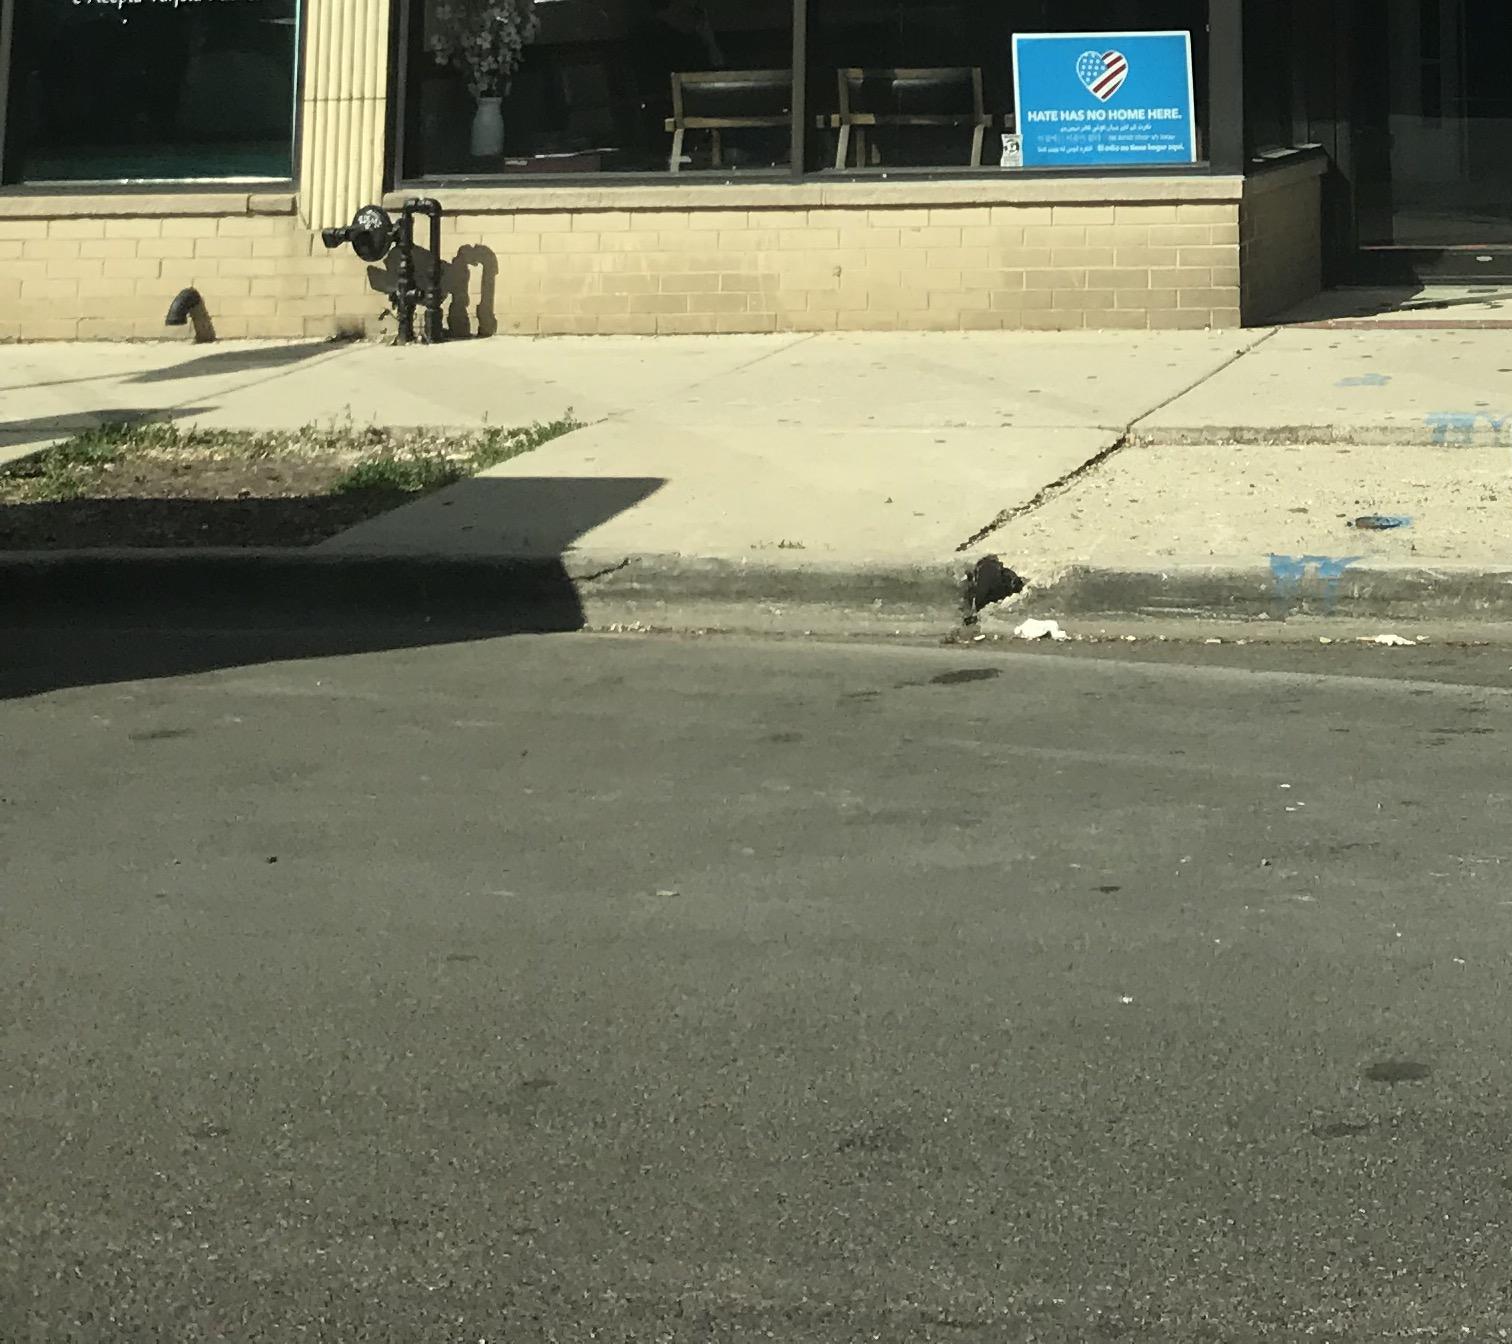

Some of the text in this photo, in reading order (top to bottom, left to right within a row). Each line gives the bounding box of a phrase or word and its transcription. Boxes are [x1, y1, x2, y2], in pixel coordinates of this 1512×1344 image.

[1027, 107, 1182, 123] HATE HAS NO HOME HERE.
